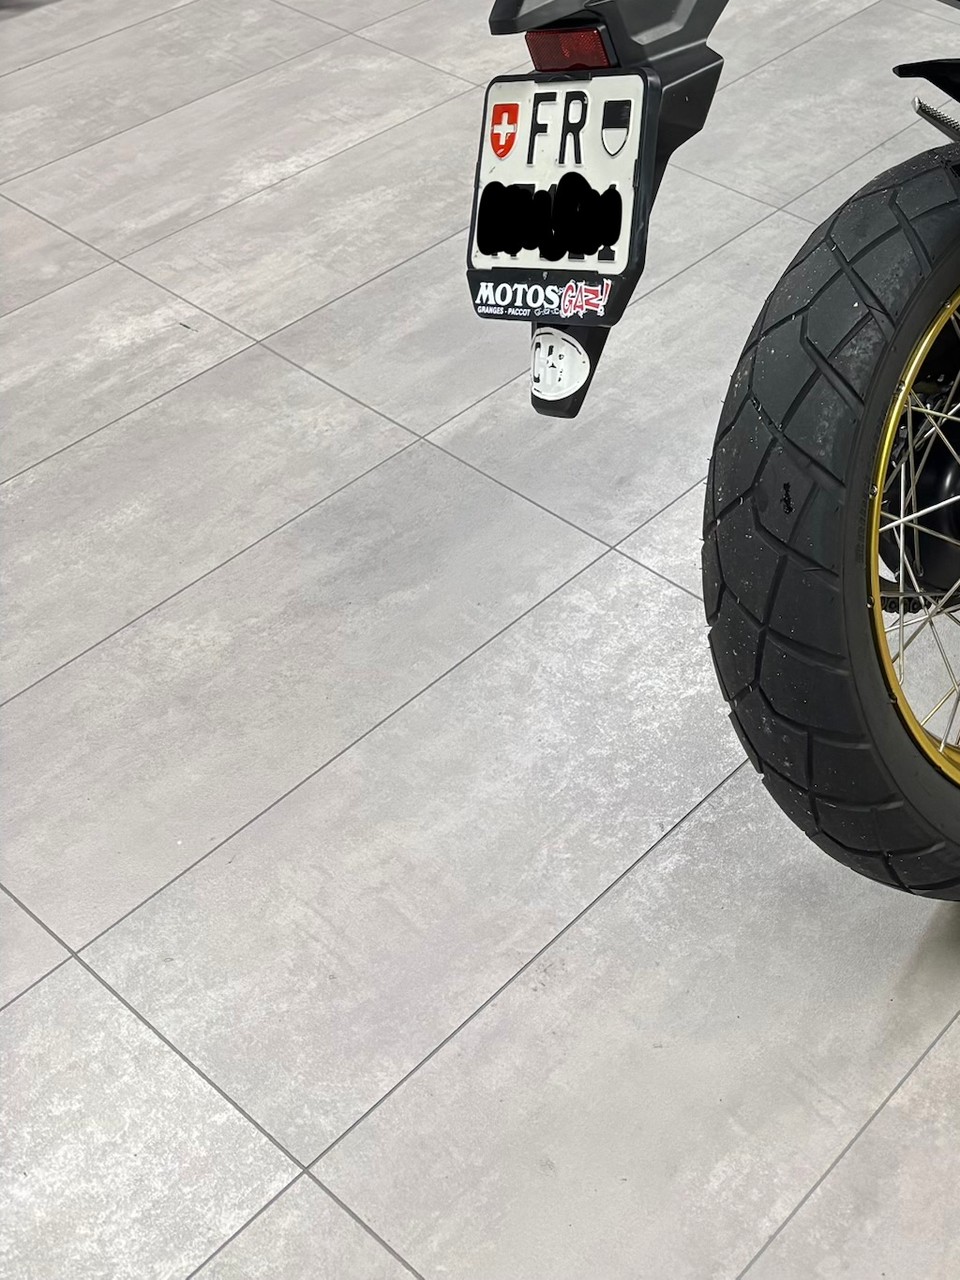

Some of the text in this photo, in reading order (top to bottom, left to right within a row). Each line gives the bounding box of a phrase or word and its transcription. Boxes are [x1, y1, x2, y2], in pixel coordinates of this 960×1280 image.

[526, 90, 588, 165] FR
[475, 282, 560, 308] MOTOS
[477, 305, 504, 315] GRANGES
[507, 307, 531, 317] PACCOT
